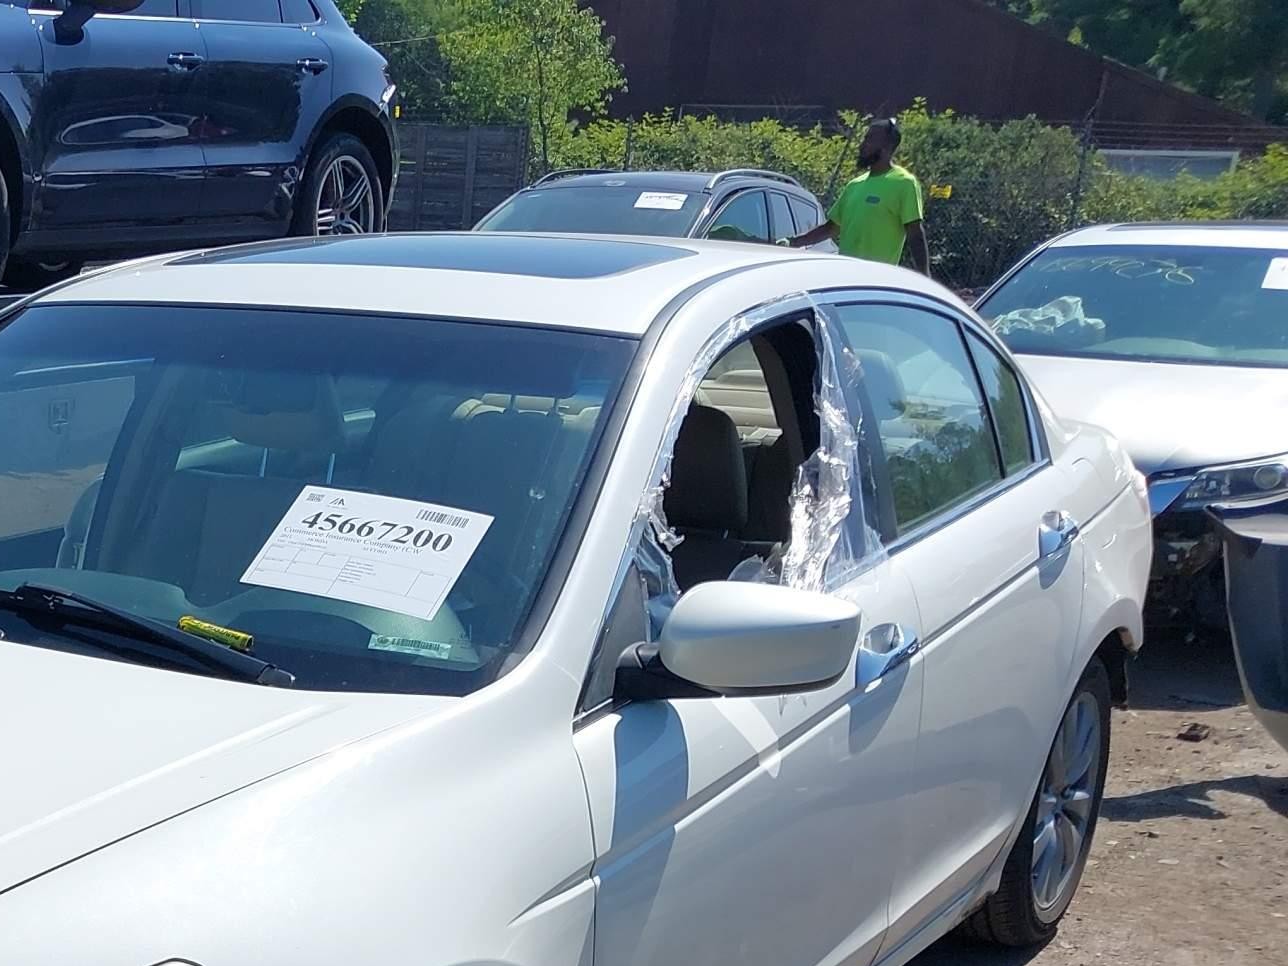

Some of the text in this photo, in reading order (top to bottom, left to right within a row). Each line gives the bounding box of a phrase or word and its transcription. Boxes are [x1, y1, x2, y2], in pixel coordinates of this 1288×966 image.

[301, 511, 453, 552] 45667200
[325, 532, 362, 544] Insurance
[363, 538, 401, 552] Company
